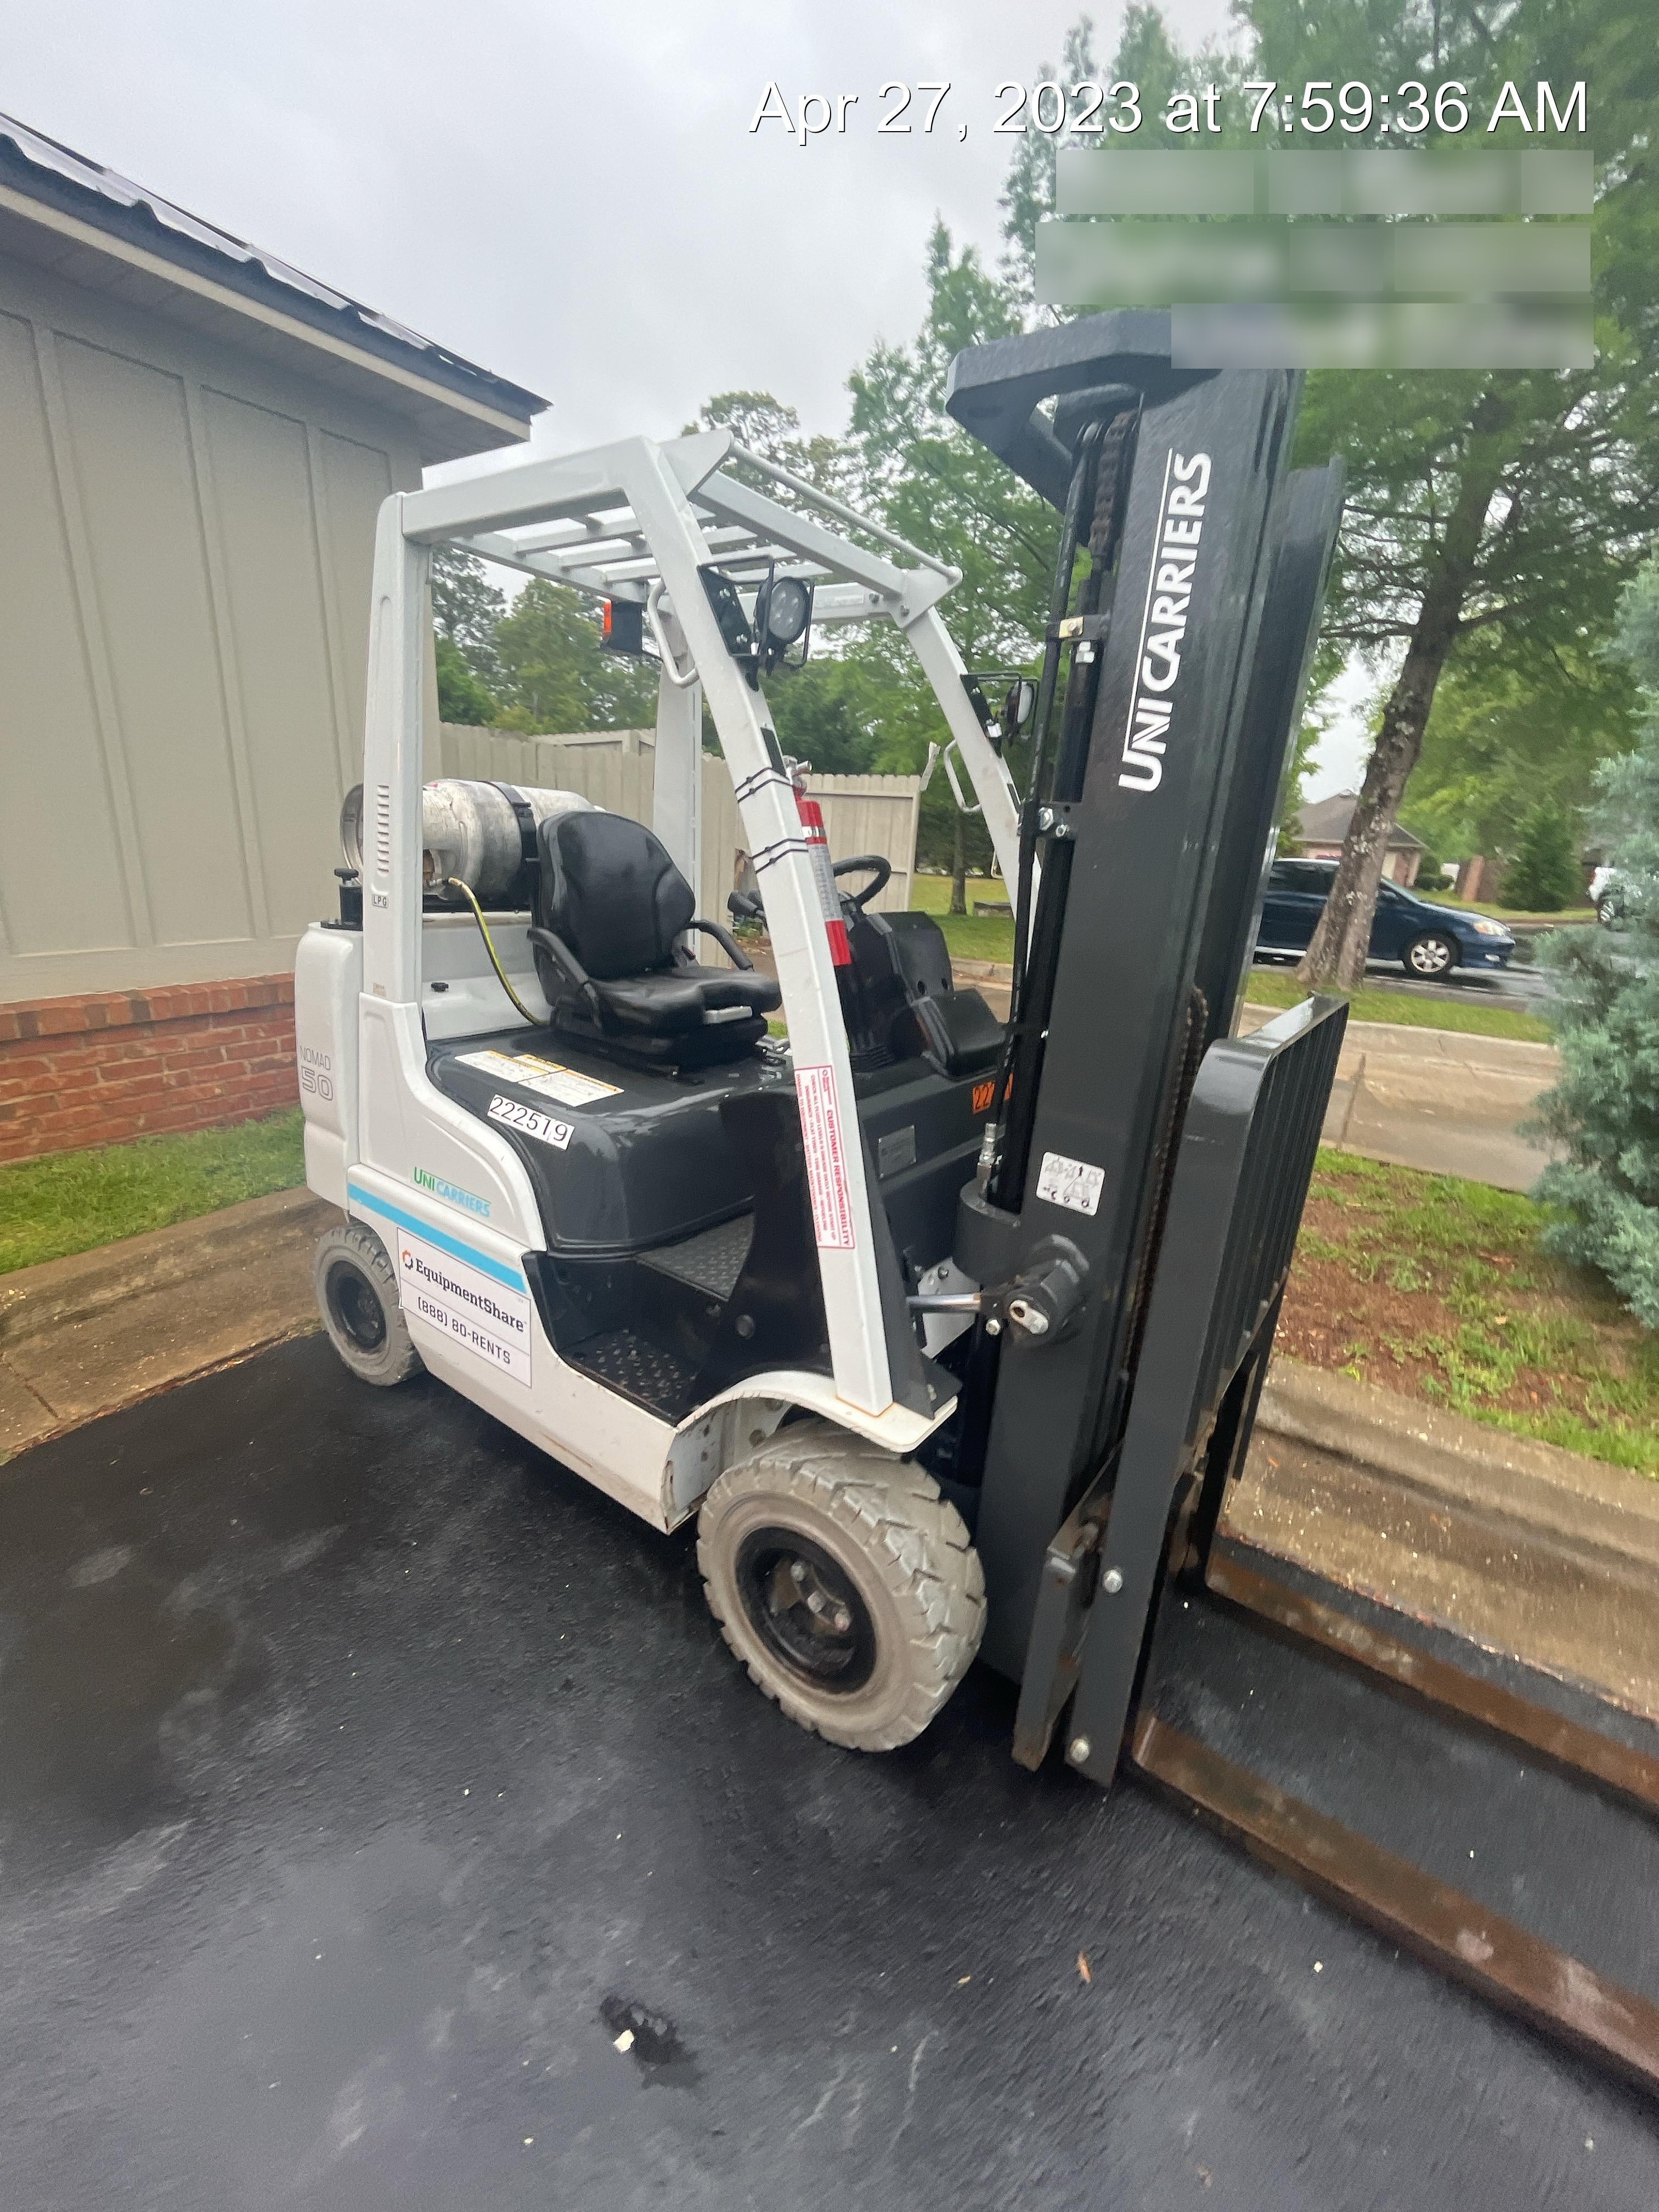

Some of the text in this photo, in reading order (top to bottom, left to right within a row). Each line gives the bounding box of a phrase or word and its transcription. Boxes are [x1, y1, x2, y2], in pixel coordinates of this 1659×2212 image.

[373, 894, 387, 907] LPG
[300, 1045, 331, 1071] NOMAD
[301, 1065, 333, 1101] 50
[489, 1097, 568, 1142] 222519
[826, 1109, 839, 1162] CUSTOMER
[833, 1165, 850, 1245] RESPONSIBILITY
[415, 1258, 524, 1333] EquipmentShare
[417, 1296, 510, 1364] (888) 80-RENTS
